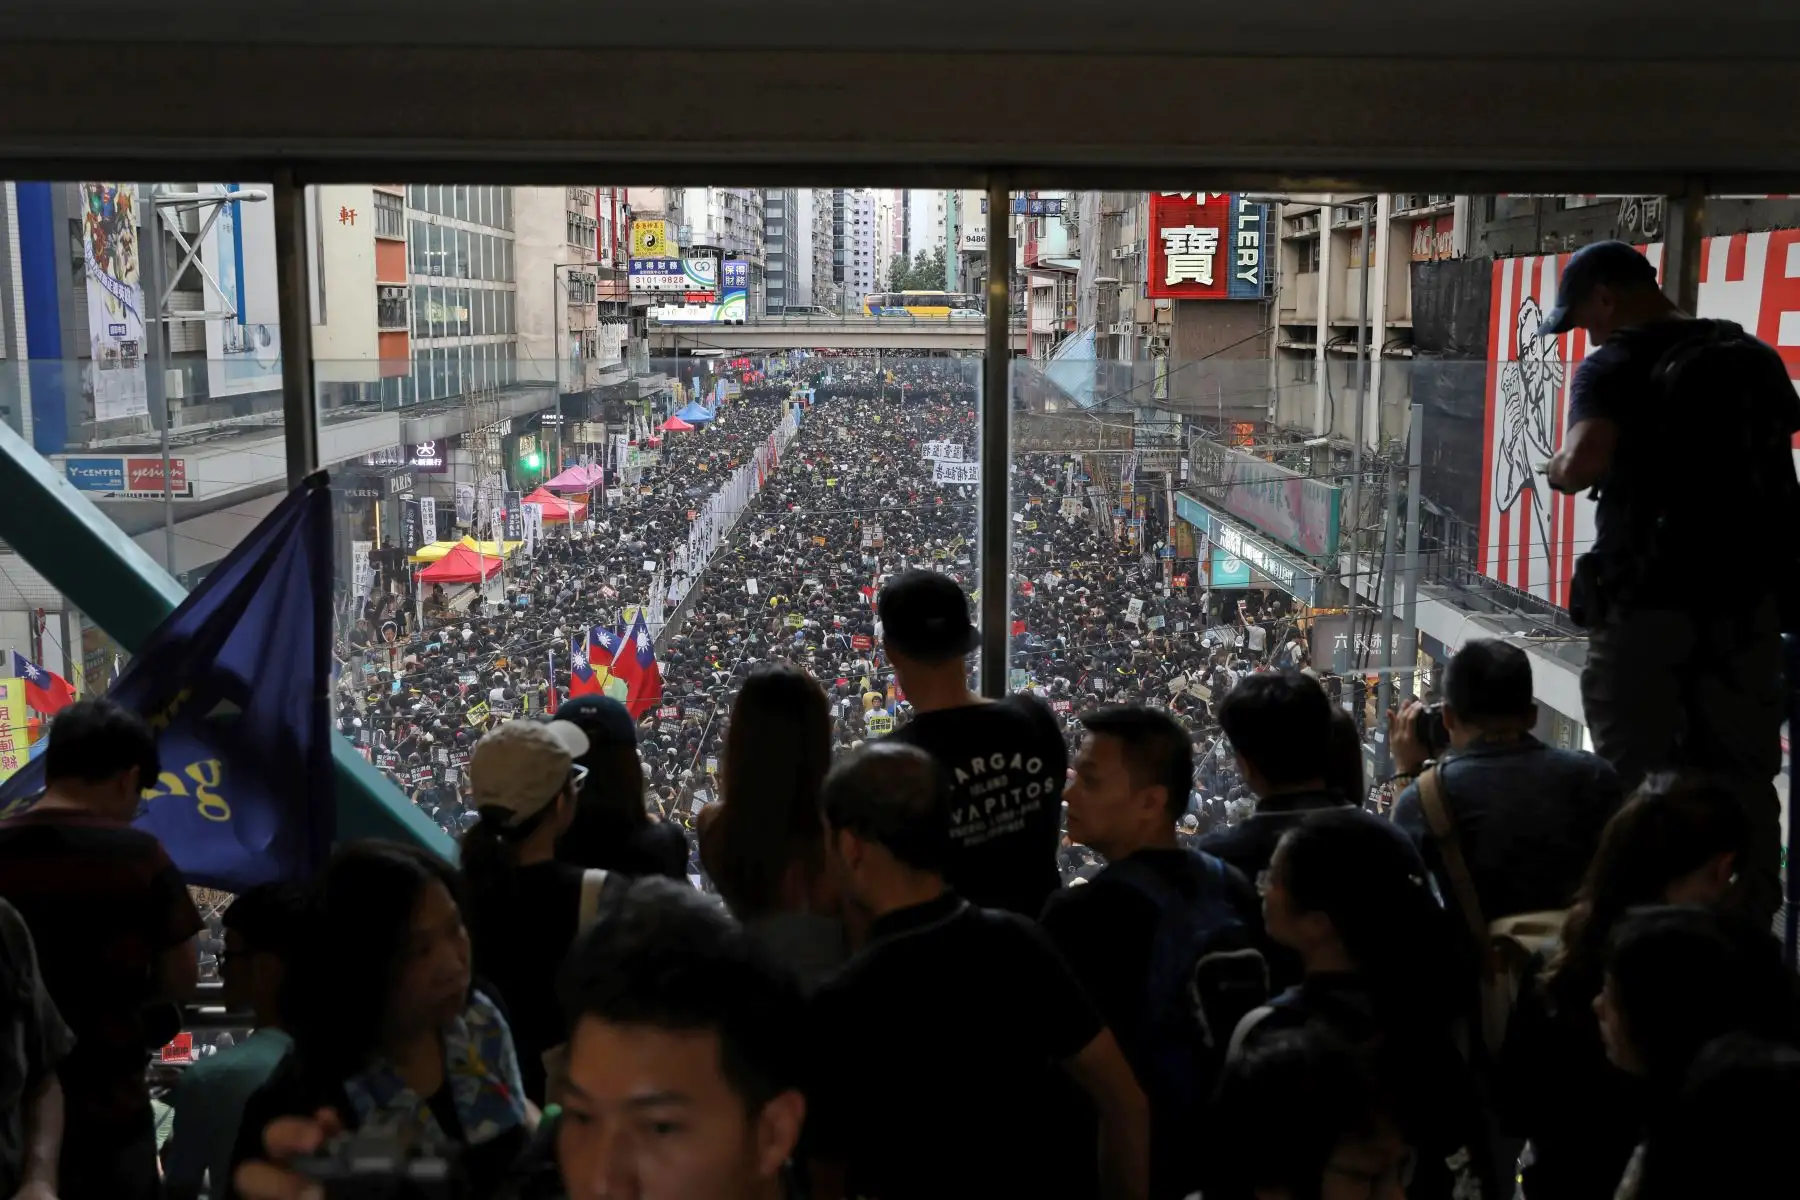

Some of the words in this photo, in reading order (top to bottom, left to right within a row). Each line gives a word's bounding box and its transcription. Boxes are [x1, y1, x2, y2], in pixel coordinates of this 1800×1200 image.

[339, 206, 358, 227] 軒
[634, 261, 678, 270] 保得財務
[725, 265, 746, 276] 保得
[725, 276, 746, 286] 財務
[69, 467, 121, 477] Y-CENTER
[390, 473, 413, 494] PARIS
[948, 752, 1044, 792] ARGAO
